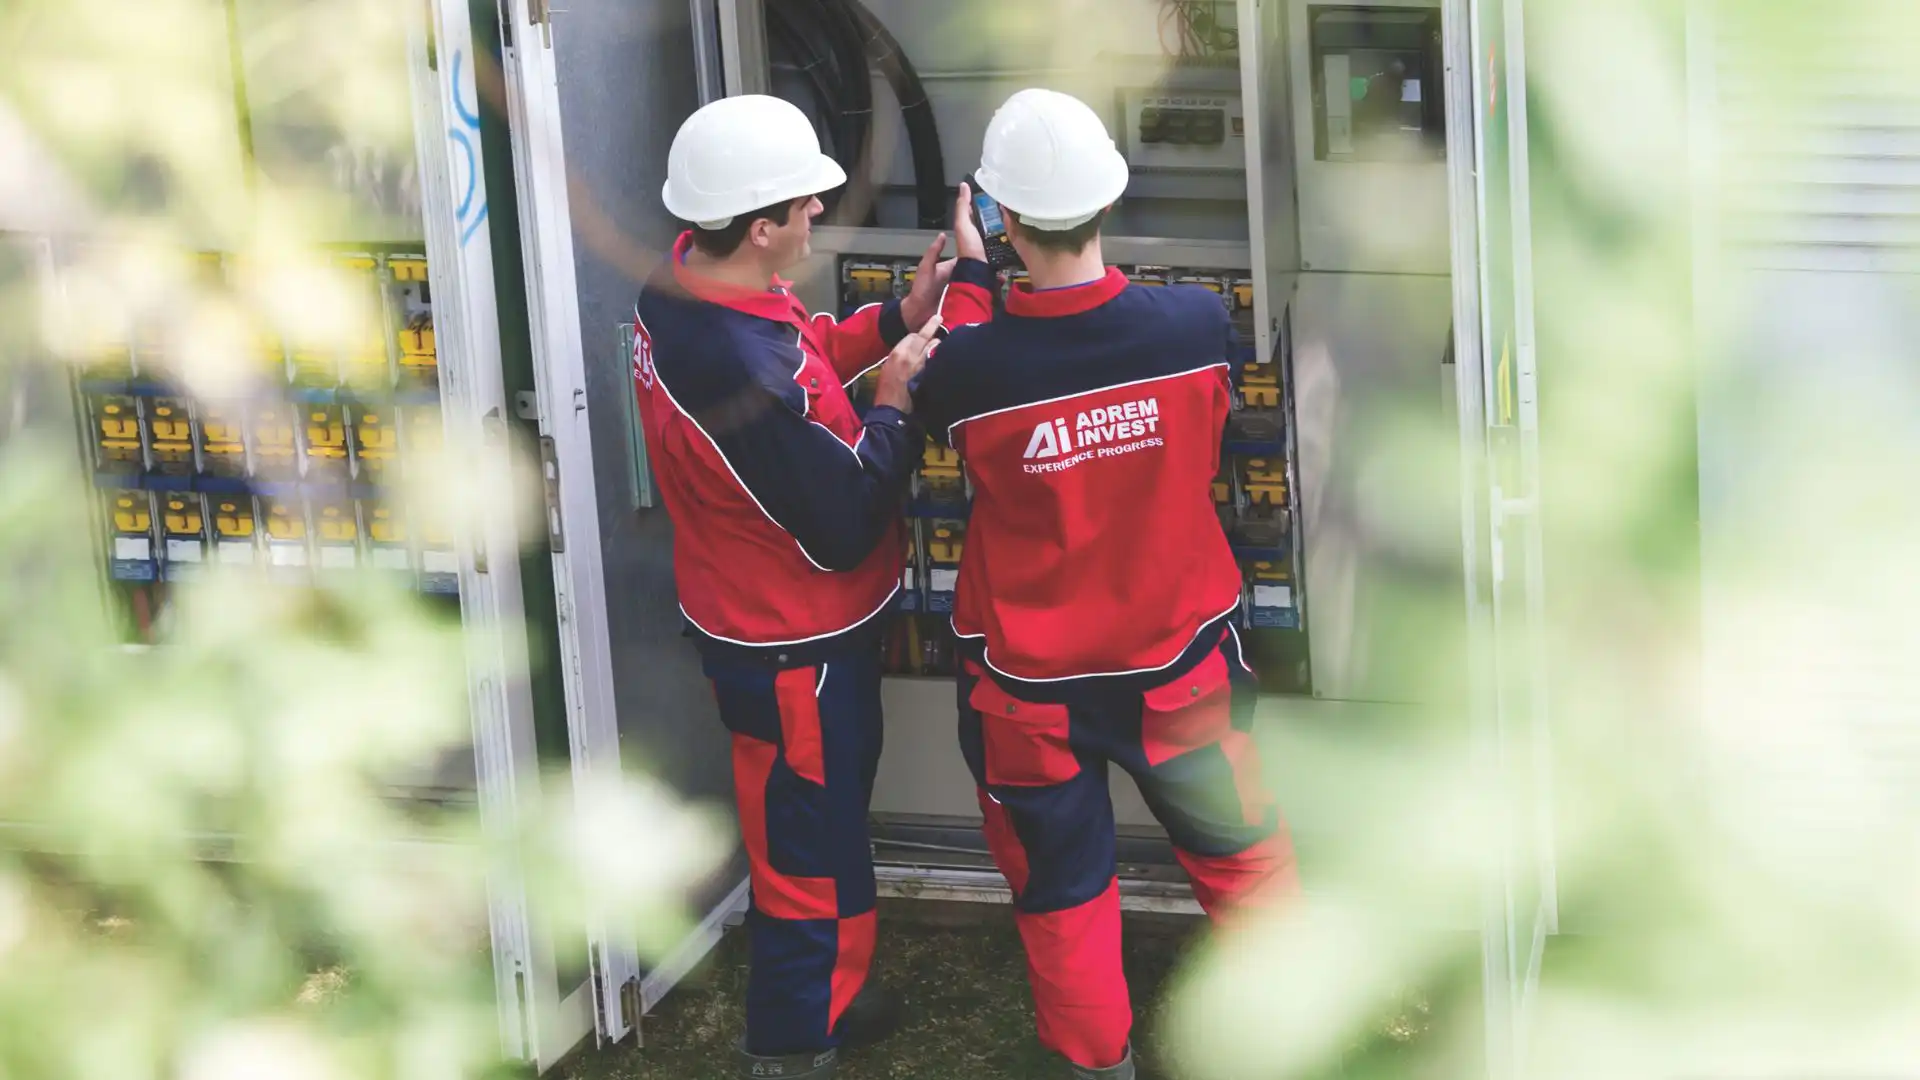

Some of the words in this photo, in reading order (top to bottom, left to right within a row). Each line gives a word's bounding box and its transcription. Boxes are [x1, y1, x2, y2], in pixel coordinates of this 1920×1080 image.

[1076, 398, 1159, 431] ADREM
[1023, 417, 1072, 459] Ai
[1077, 417, 1159, 448] INVEST
[1023, 450, 1095, 474] EXPERIENCE
[1097, 437, 1164, 458] PROGRESS
